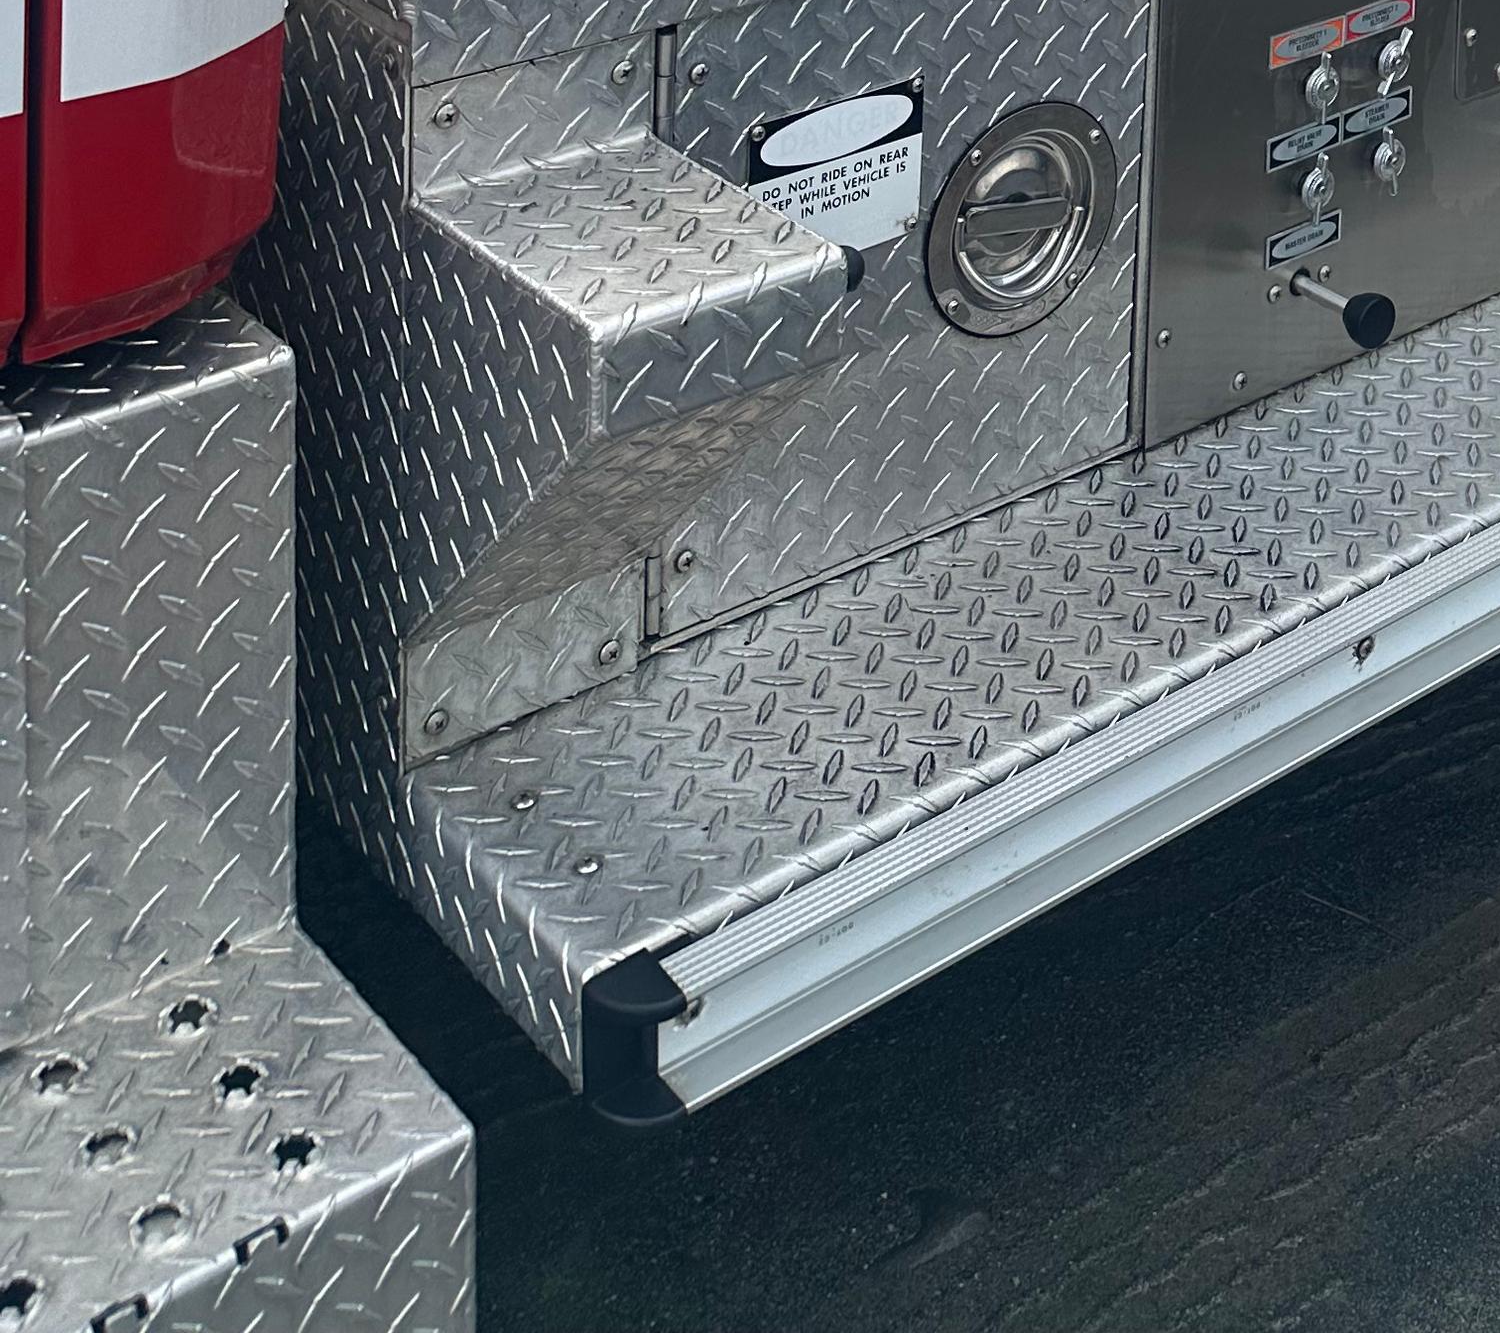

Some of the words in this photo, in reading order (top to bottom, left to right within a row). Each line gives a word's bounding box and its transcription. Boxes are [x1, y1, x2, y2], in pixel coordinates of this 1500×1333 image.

[778, 101, 899, 157] DANGER
[762, 187, 781, 202] DO
[788, 176, 815, 194] NOT
[821, 166, 848, 183] RIDE
[853, 158, 873, 173] ON
[879, 146, 909, 165] REAR
[772, 197, 793, 212] TEP
[799, 183, 836, 205] WHILE
[843, 166, 890, 191] VEHICLE
[896, 161, 906, 174] IS
[800, 204, 814, 219] IN
[821, 187, 871, 213] MOTION
